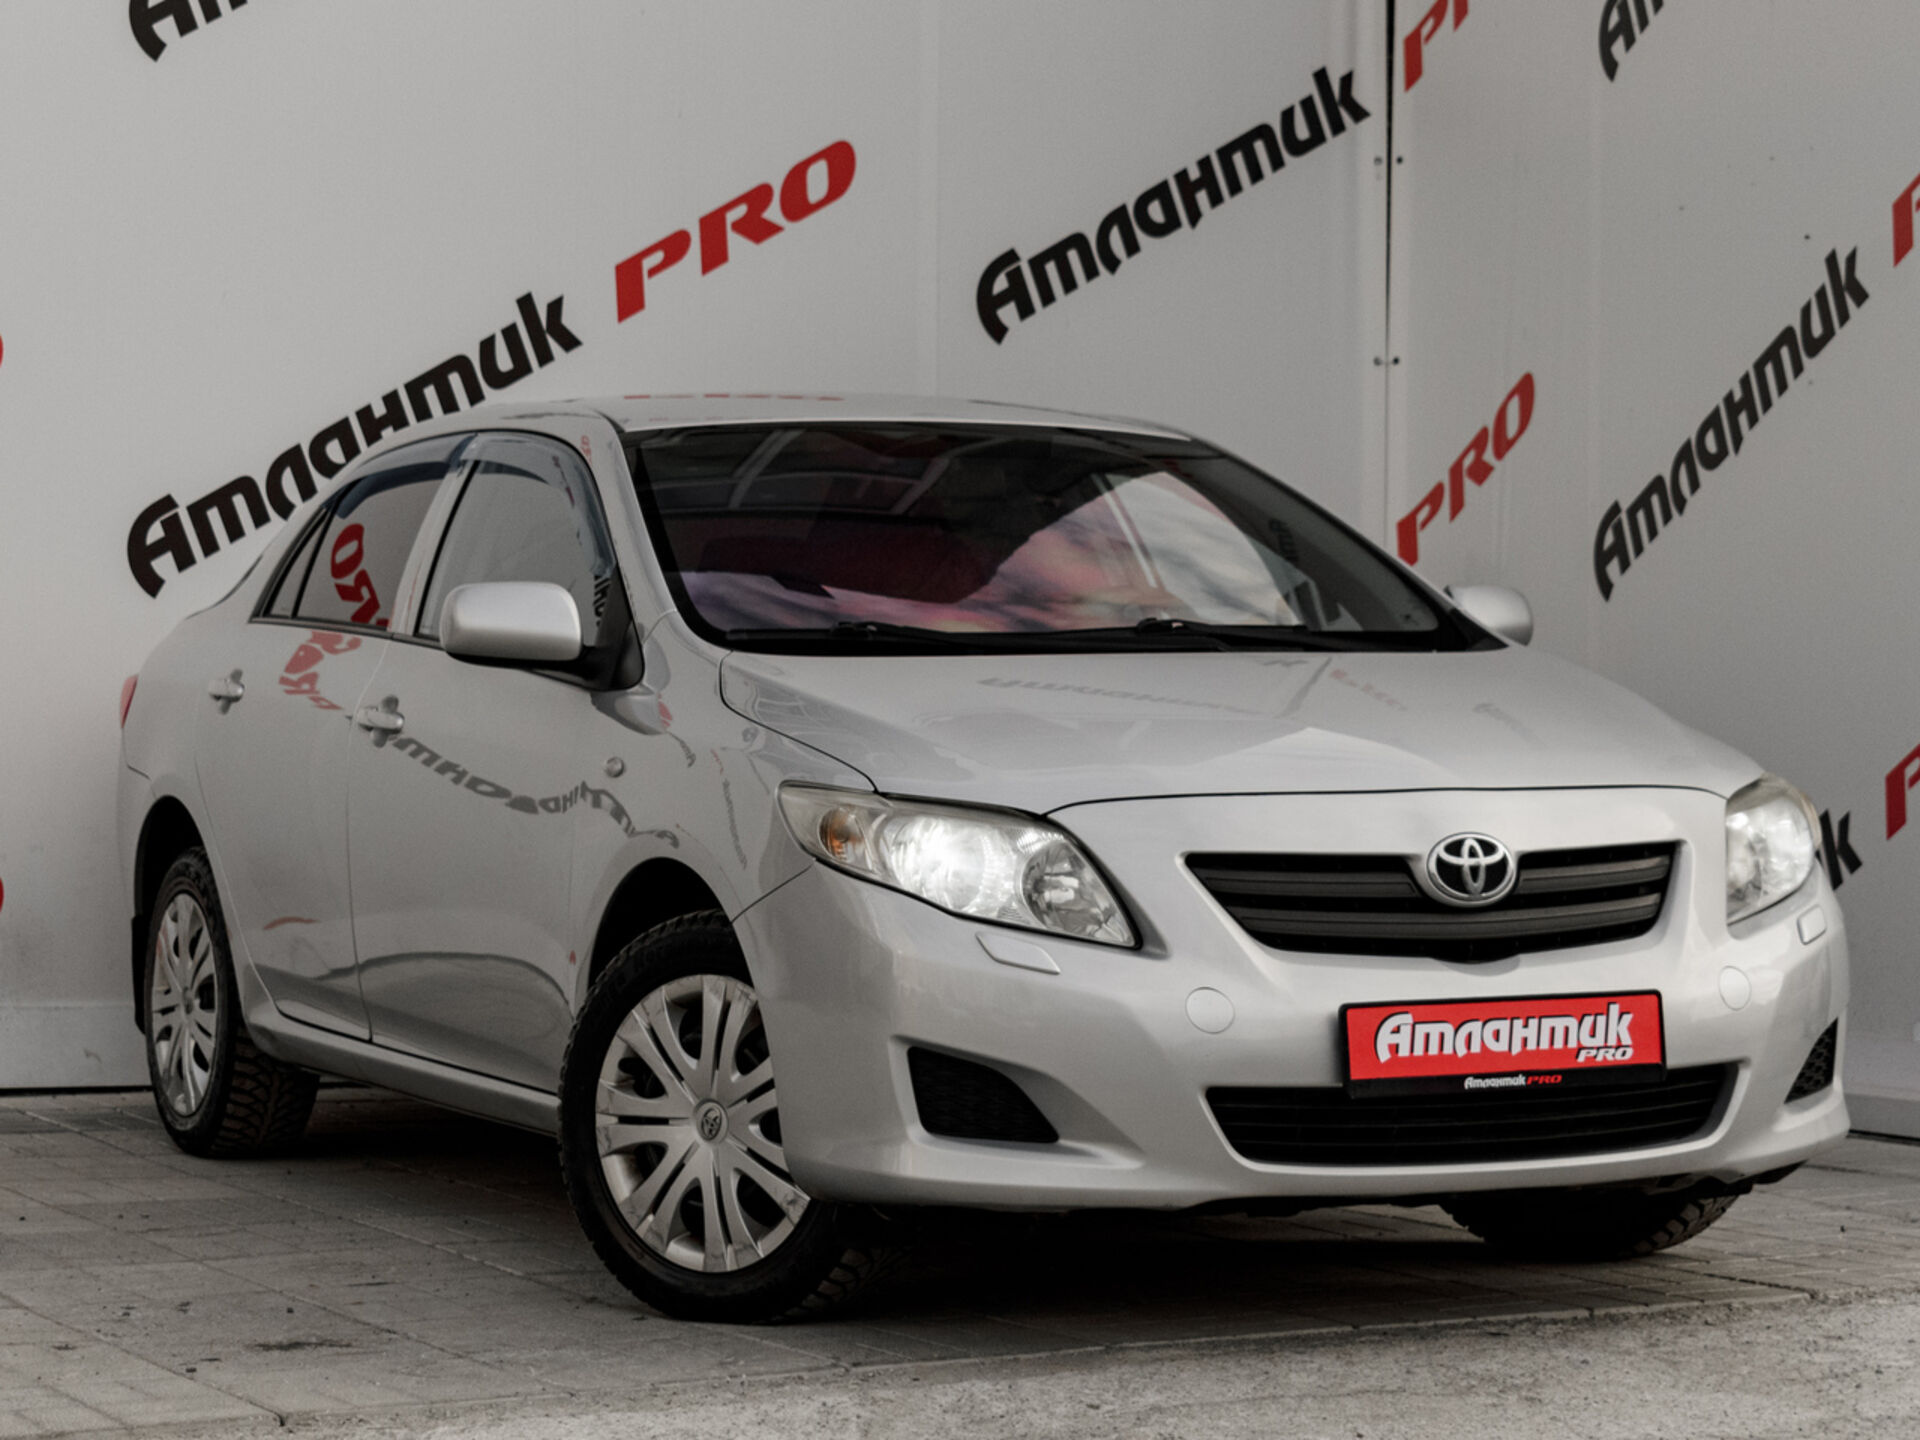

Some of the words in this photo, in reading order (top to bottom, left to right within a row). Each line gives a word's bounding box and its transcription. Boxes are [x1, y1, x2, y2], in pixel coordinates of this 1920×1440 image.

[615, 140, 857, 324] PRO
[1397, 373, 1535, 566] PRO
[1526, 1074, 1563, 1086] PRO
[1576, 1046, 1634, 1063] PRO
